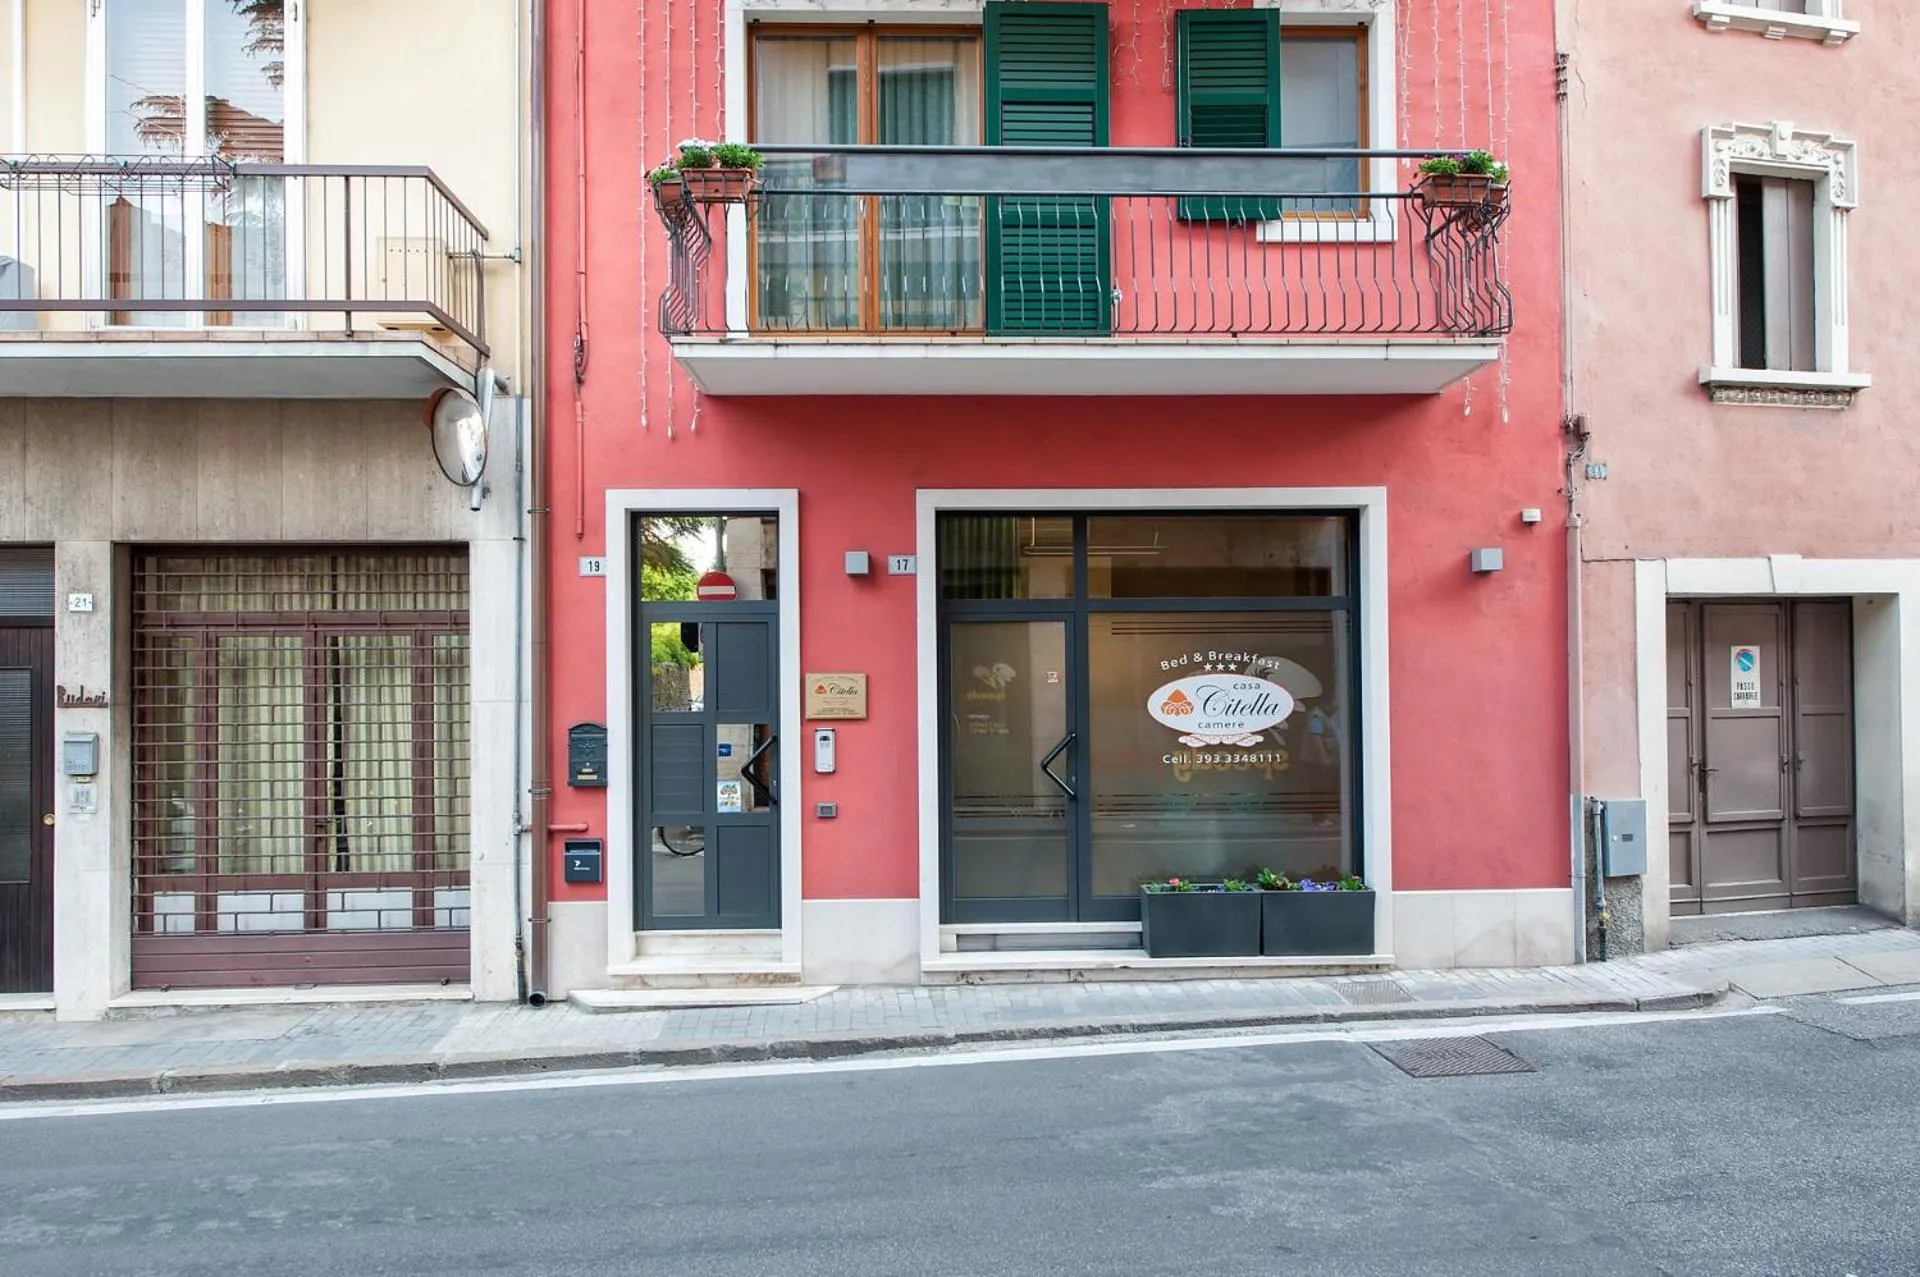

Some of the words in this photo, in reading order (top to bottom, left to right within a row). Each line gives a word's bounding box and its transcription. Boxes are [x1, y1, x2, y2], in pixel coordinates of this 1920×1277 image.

[588, 560, 600, 572] 19
[896, 558, 908, 571] 17
[74, 597, 87, 608] 21
[1160, 654, 1188, 670] Bed
[1193, 652, 1203, 663] &
[1208, 650, 1281, 670] Breakfast
[1233, 682, 1261, 690] casa
[1196, 684, 1280, 718] Citella
[1197, 721, 1245, 729] camere
[1162, 753, 1192, 764] Cell.
[1196, 753, 1220, 764] 393
[1225, 753, 1281, 764] 3348111
